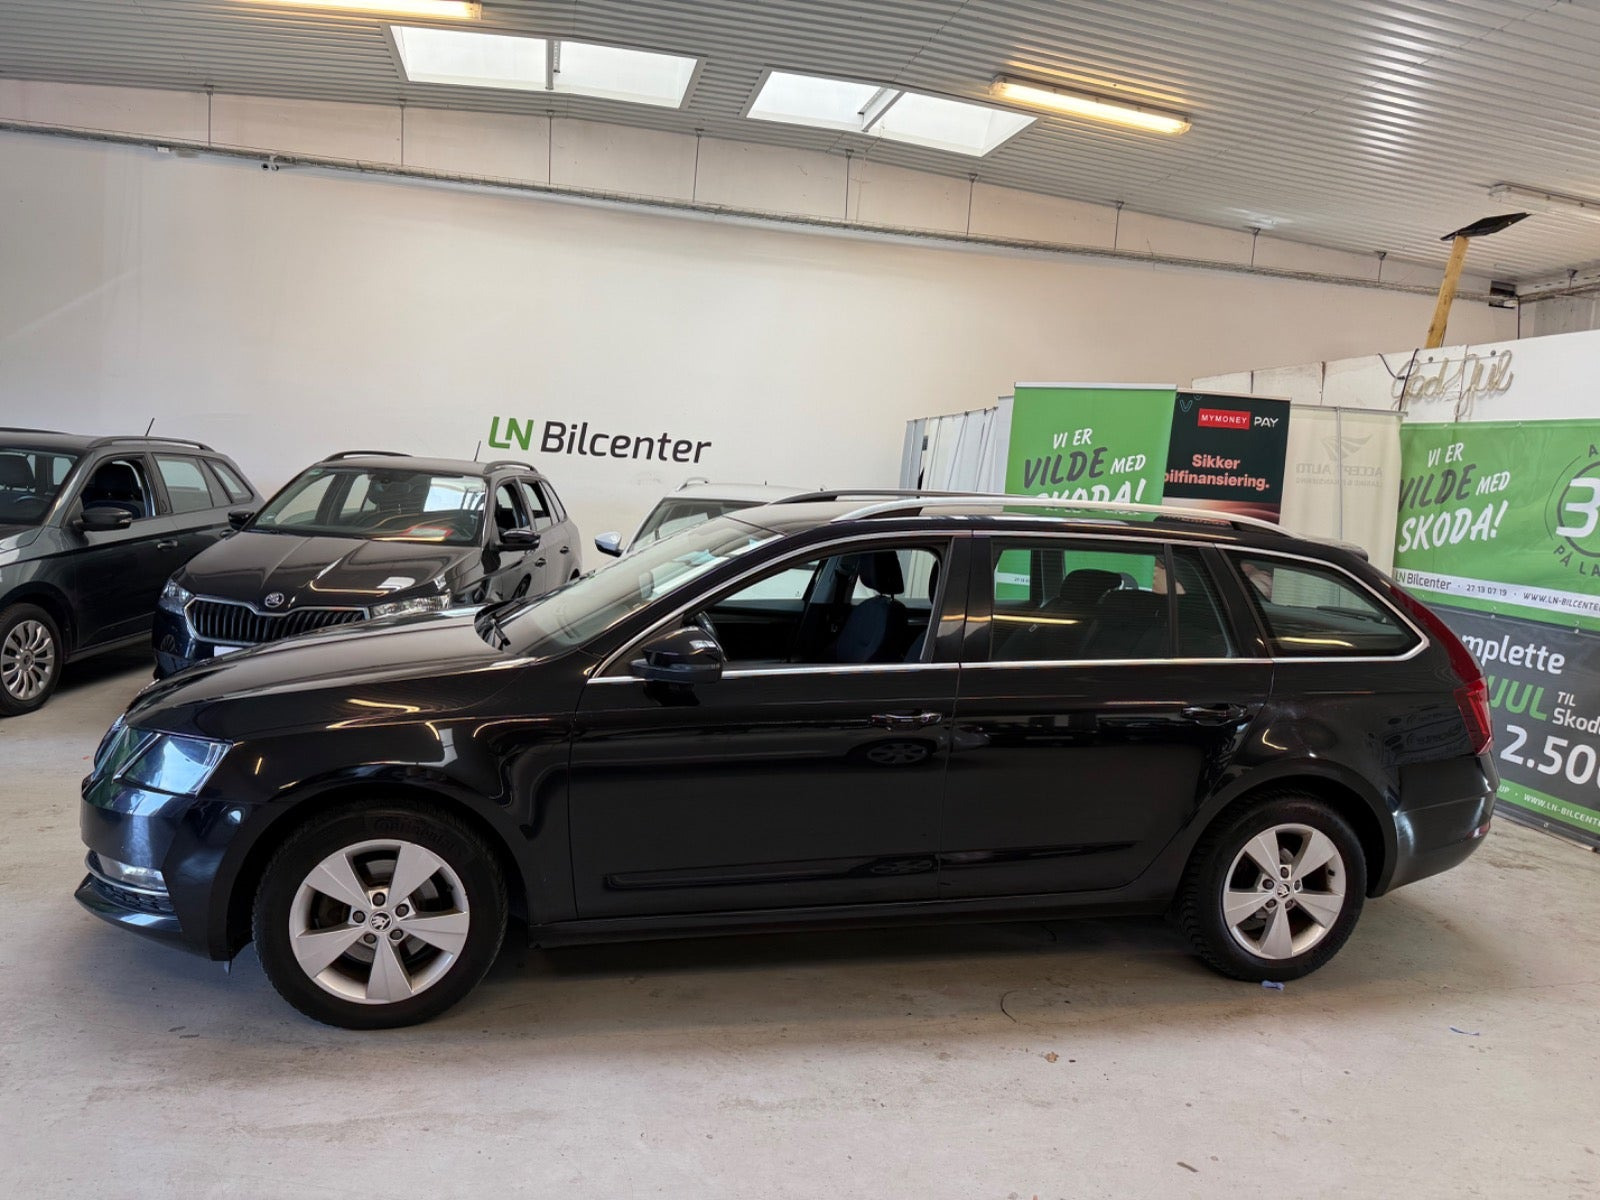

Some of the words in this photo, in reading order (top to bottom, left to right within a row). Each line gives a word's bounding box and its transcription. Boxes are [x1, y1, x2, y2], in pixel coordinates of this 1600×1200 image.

[488, 416, 534, 451] LN
[540, 420, 712, 464] Bilcenter
[1053, 431, 1068, 450] VI
[1072, 428, 1093, 446] ER
[1200, 414, 1248, 425] MYMONEY
[1253, 416, 1279, 428] PAY
[1024, 447, 1108, 488] VILDE
[1110, 454, 1146, 475] MED
[1192, 453, 1241, 470] Sikker
[1427, 447, 1441, 468] VI
[1445, 442, 1464, 463] ER
[1398, 464, 1477, 512] VILDE
[1476, 471, 1510, 496] MED
[1398, 500, 1509, 553] SKODA!
[1395, 571, 1406, 583] LN
[1406, 573, 1452, 591] Bilcenter
[1466, 584, 1475, 592] 27
[1499, 588, 1507, 596] 19
[1523, 592, 1600, 612] WWW.LN-BILCENTE
[1488, 675, 1548, 721] JUL
[1557, 691, 1576, 707] TIL
[1552, 708, 1600, 735] Skod
[1500, 724, 1600, 789] 2.50
